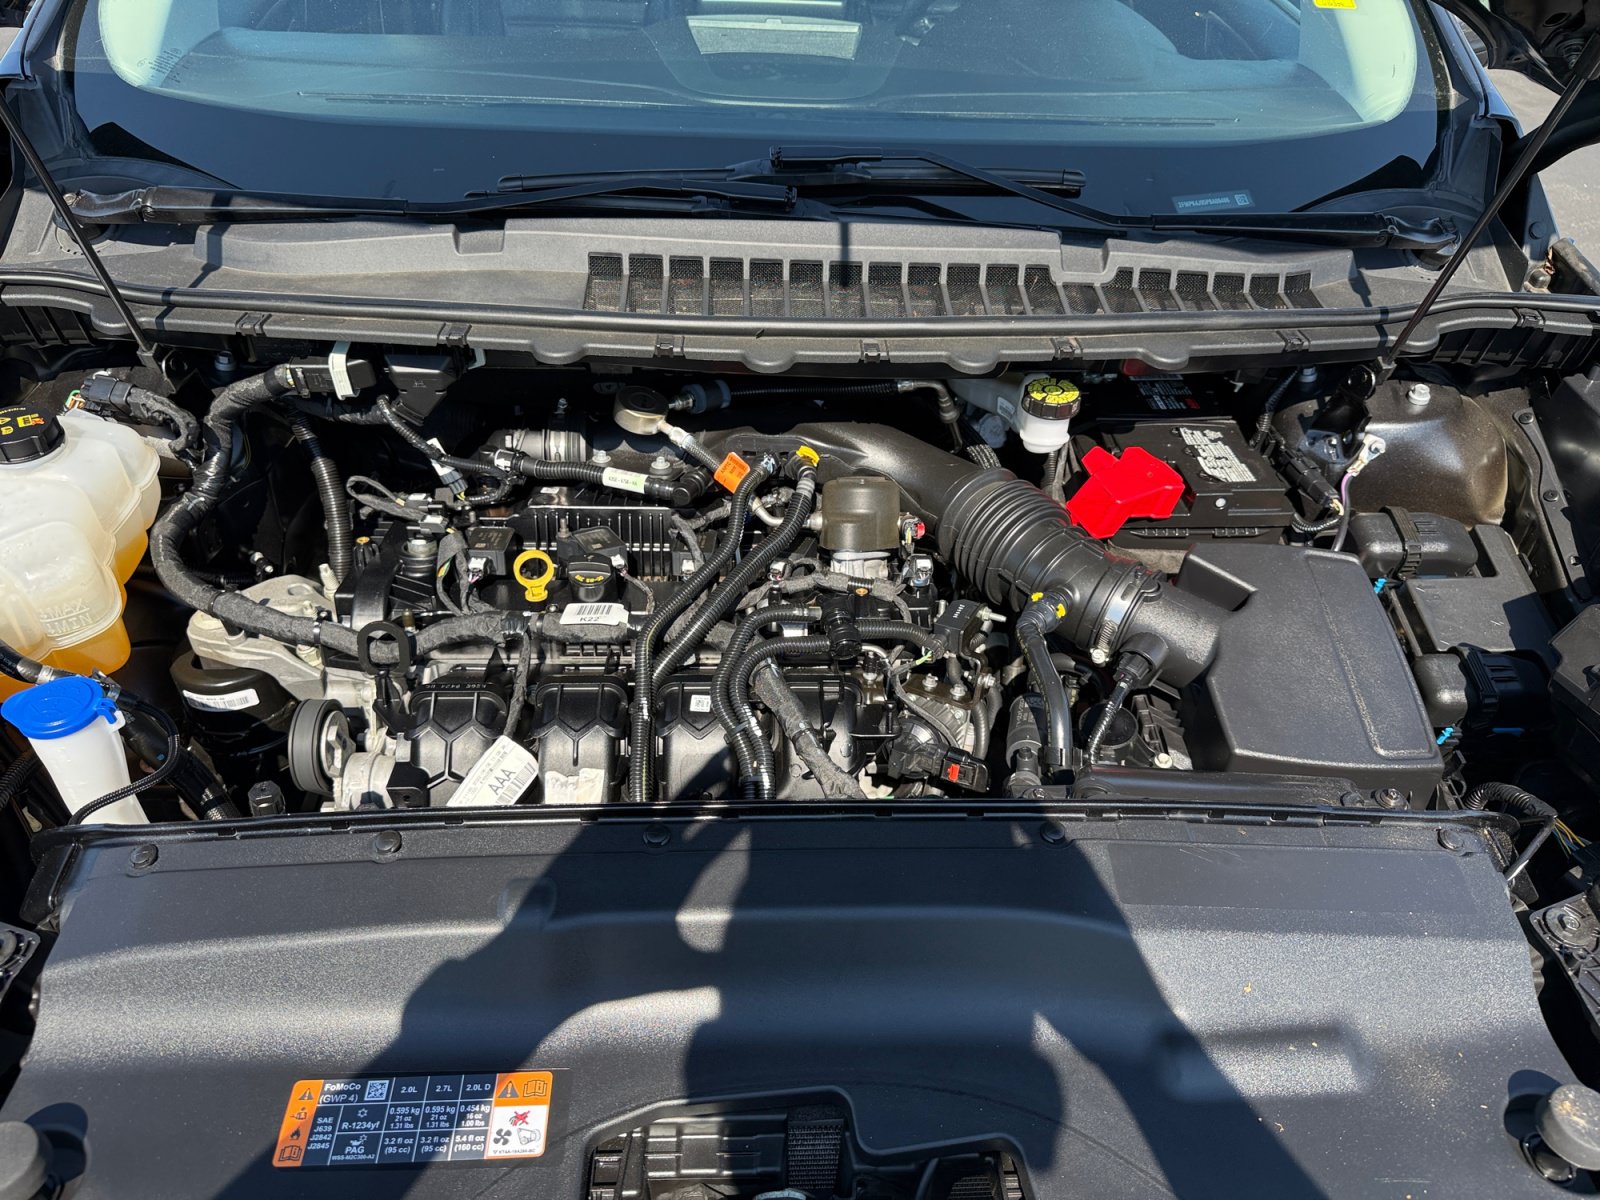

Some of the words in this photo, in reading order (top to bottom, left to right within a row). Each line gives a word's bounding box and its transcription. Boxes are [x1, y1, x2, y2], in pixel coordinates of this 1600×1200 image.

[488, 769, 516, 795] AAA
[324, 1083, 361, 1091] FoMoCo
[320, 1094, 347, 1103] (GWP
[411, 1107, 420, 1115] kg
[446, 1106, 456, 1114] kg
[481, 1105, 491, 1113] kg
[341, 1121, 380, 1131] R-1234yf
[384, 1137, 396, 1145] 3.2
[345, 1146, 365, 1154] PAG
[385, 1146, 397, 1155] (95
[398, 1146, 410, 1154] cc)
[435, 1145, 447, 1153] cc)
[472, 1143, 484, 1151] cc)
